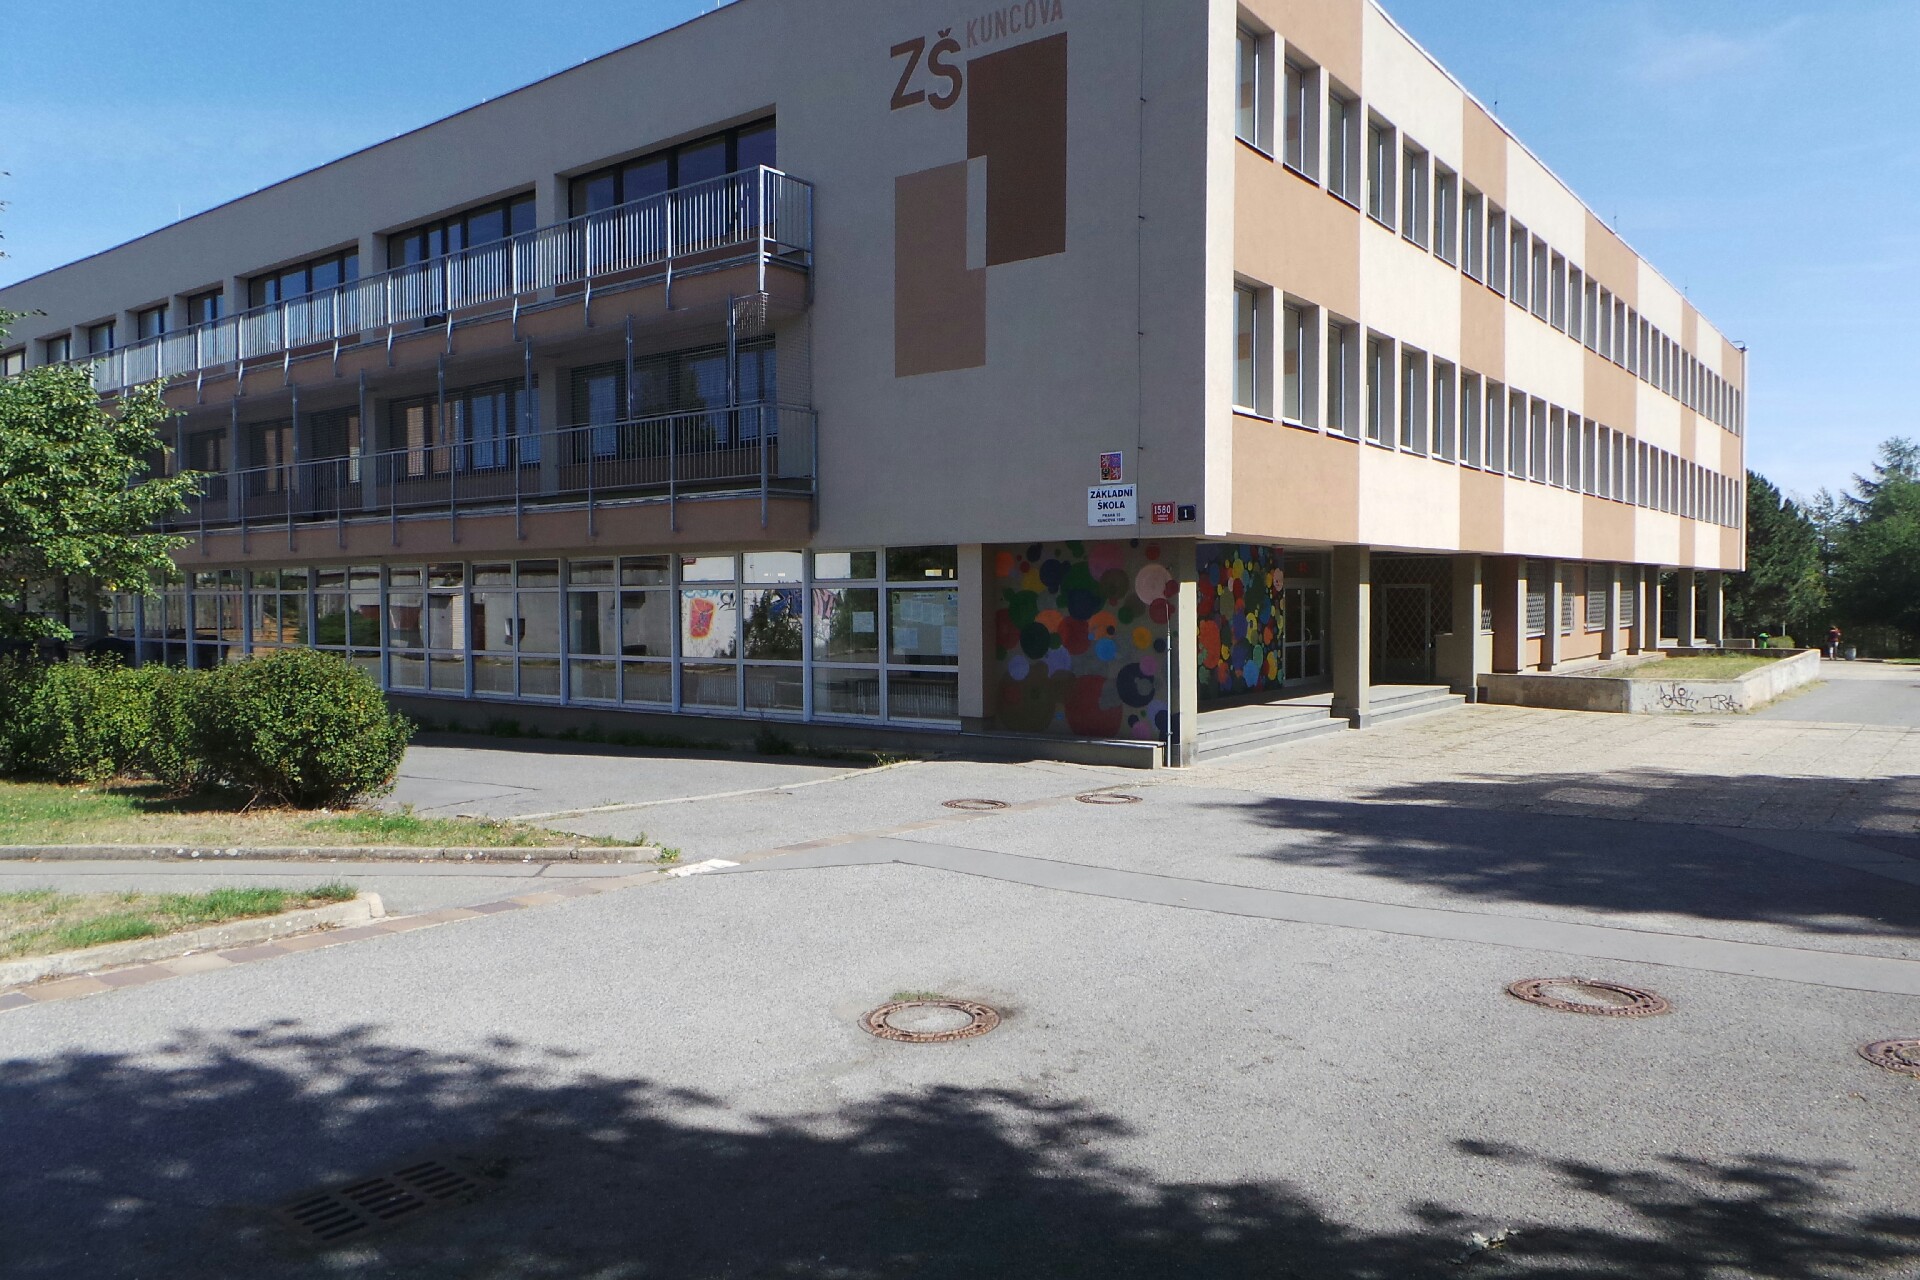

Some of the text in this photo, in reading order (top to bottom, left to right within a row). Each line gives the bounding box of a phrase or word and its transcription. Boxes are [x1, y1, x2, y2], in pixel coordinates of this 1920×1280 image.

[966, 0, 1063, 48] KUNCOVA
[890, 27, 963, 111] ZŠ
[1090, 486, 1133, 499] ZÁKLADNÍ
[1097, 499, 1126, 510] ŠKOLA
[1154, 504, 1171, 515] 1580
[1184, 508, 1188, 519] 1
